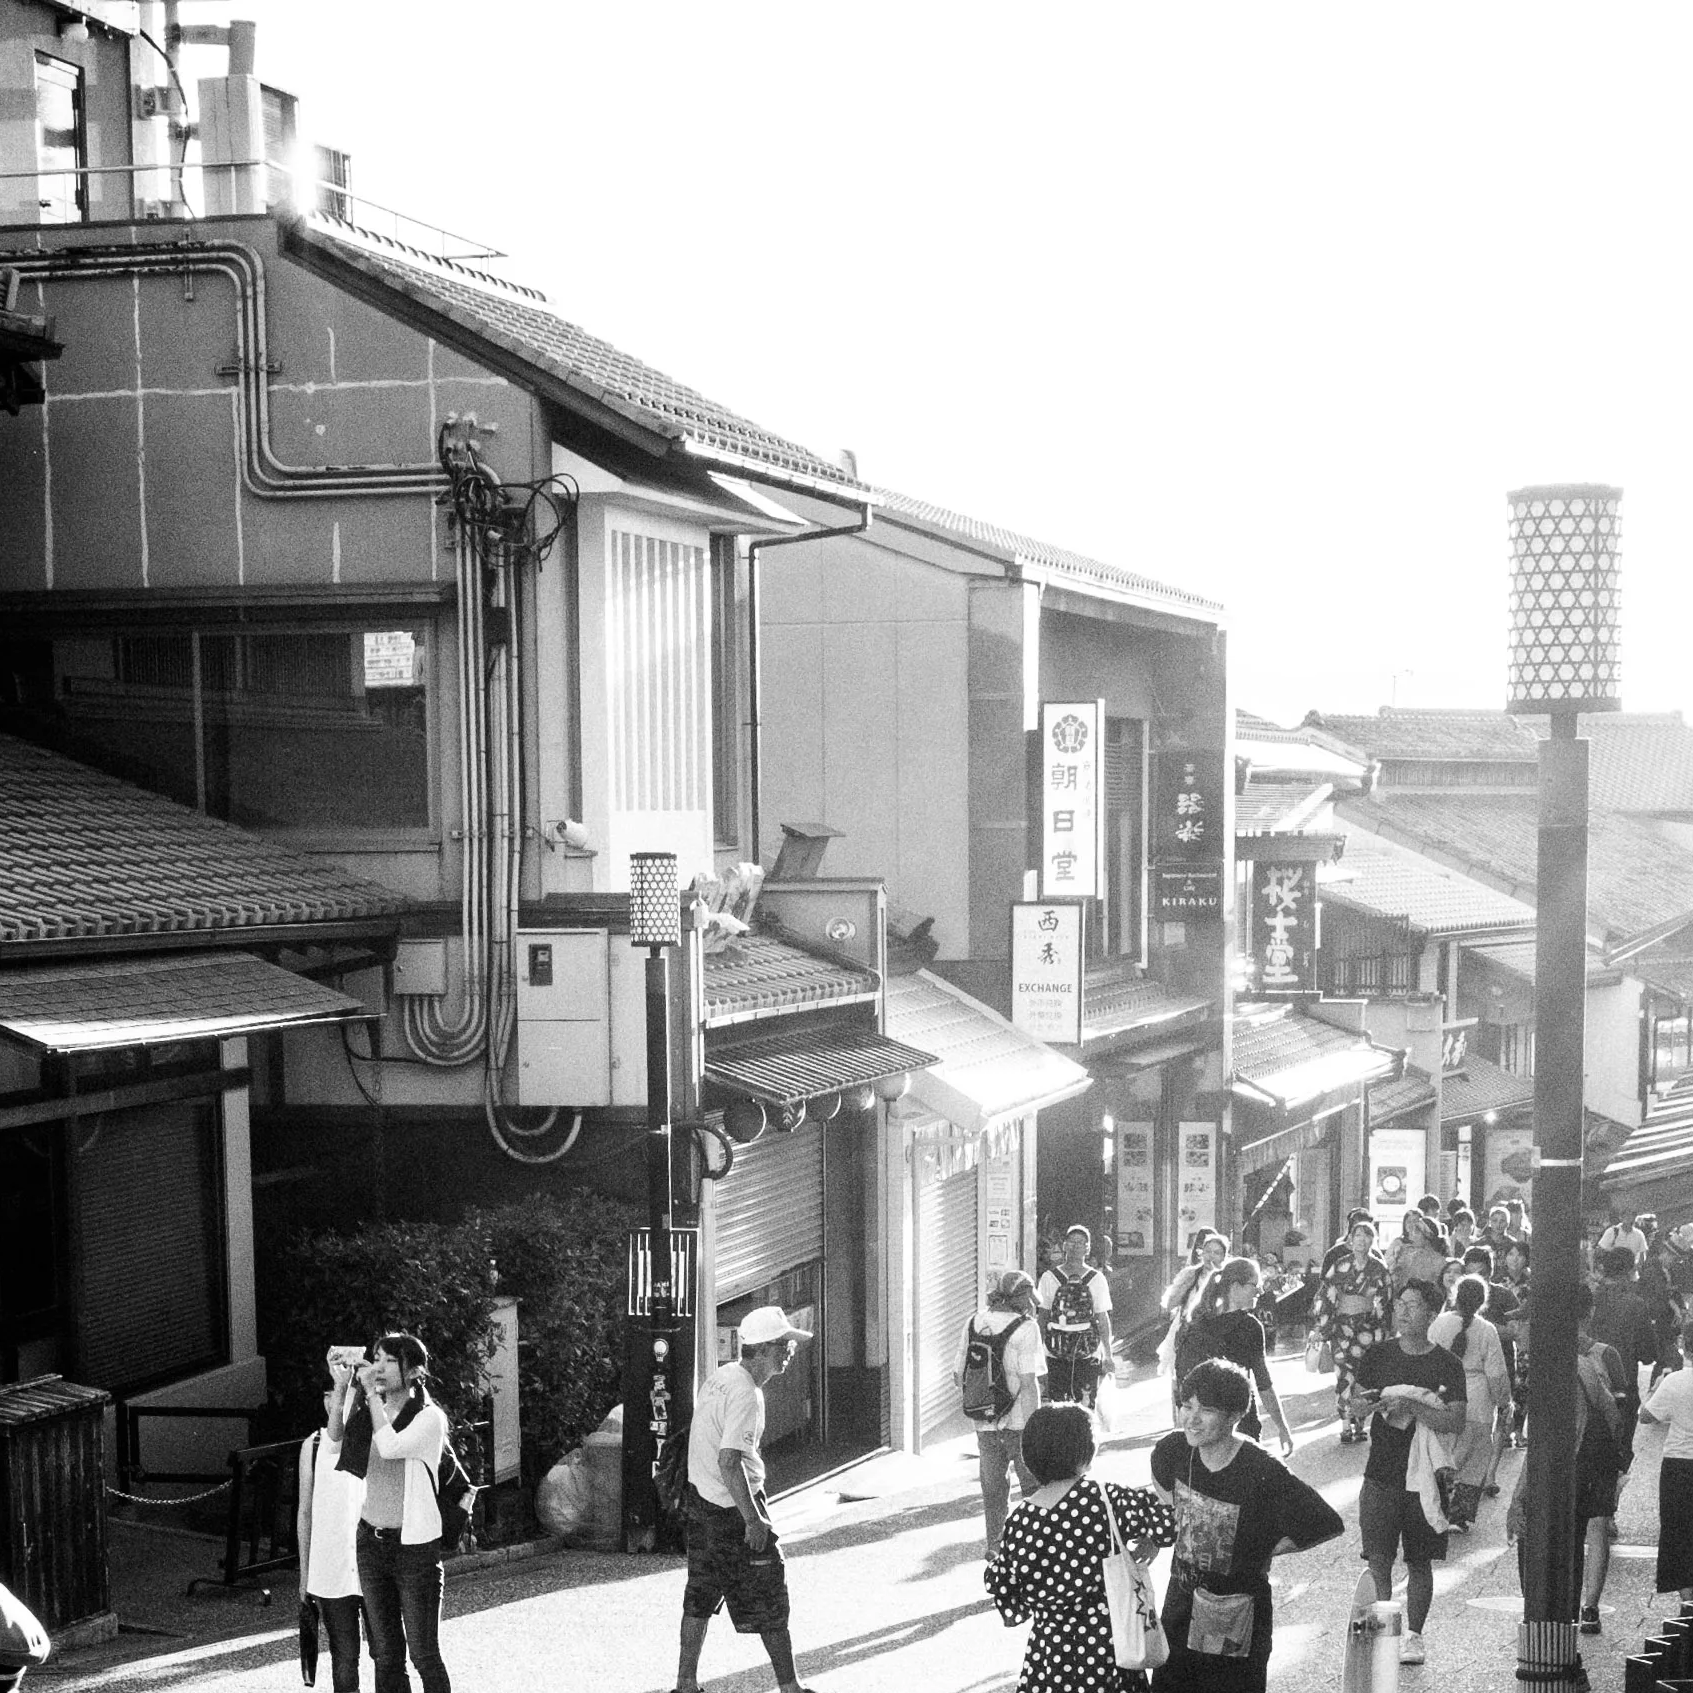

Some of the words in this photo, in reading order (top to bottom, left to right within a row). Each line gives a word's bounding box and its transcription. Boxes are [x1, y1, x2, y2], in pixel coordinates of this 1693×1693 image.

[1050, 762, 1079, 882] 朝日堂
[1162, 897, 1218, 906] KIRAKU
[1037, 909, 1060, 966] 西秀
[1018, 982, 1073, 994] EXCHANGE
